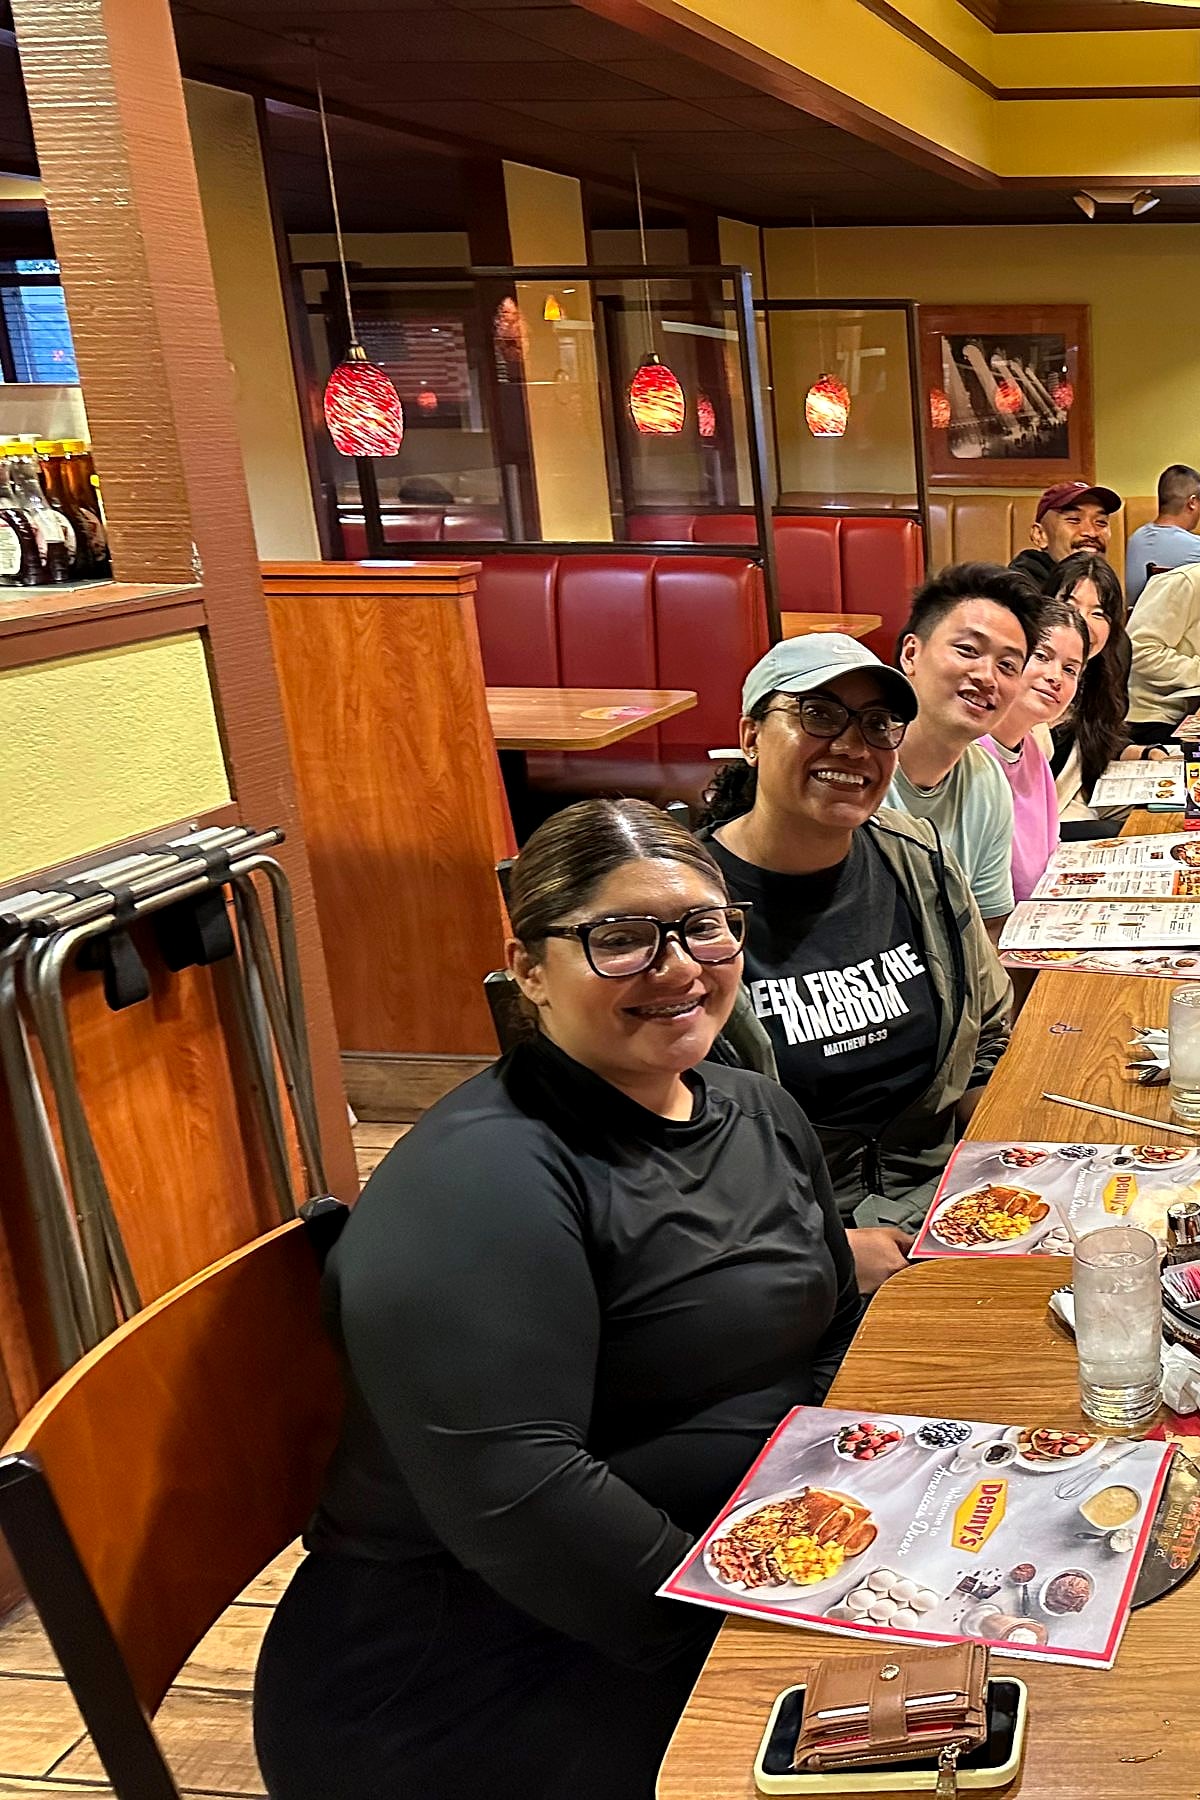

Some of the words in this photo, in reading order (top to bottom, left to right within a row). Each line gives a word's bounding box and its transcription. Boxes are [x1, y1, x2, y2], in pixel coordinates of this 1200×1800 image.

[749, 977, 802, 1018] EEK
[802, 958, 879, 1005] FIRST
[781, 983, 909, 1046] KINGDOM
[823, 1033, 866, 1057] MATTHEW
[868, 1029, 888, 1045] 6:33
[1110, 1176, 1132, 1211] Denny's
[914, 1465, 953, 1518] America's
[933, 1487, 962, 1525] Welcome
[929, 1527, 940, 1536] to
[960, 1484, 1003, 1546] Denny's
[897, 1521, 929, 1556] Diner
